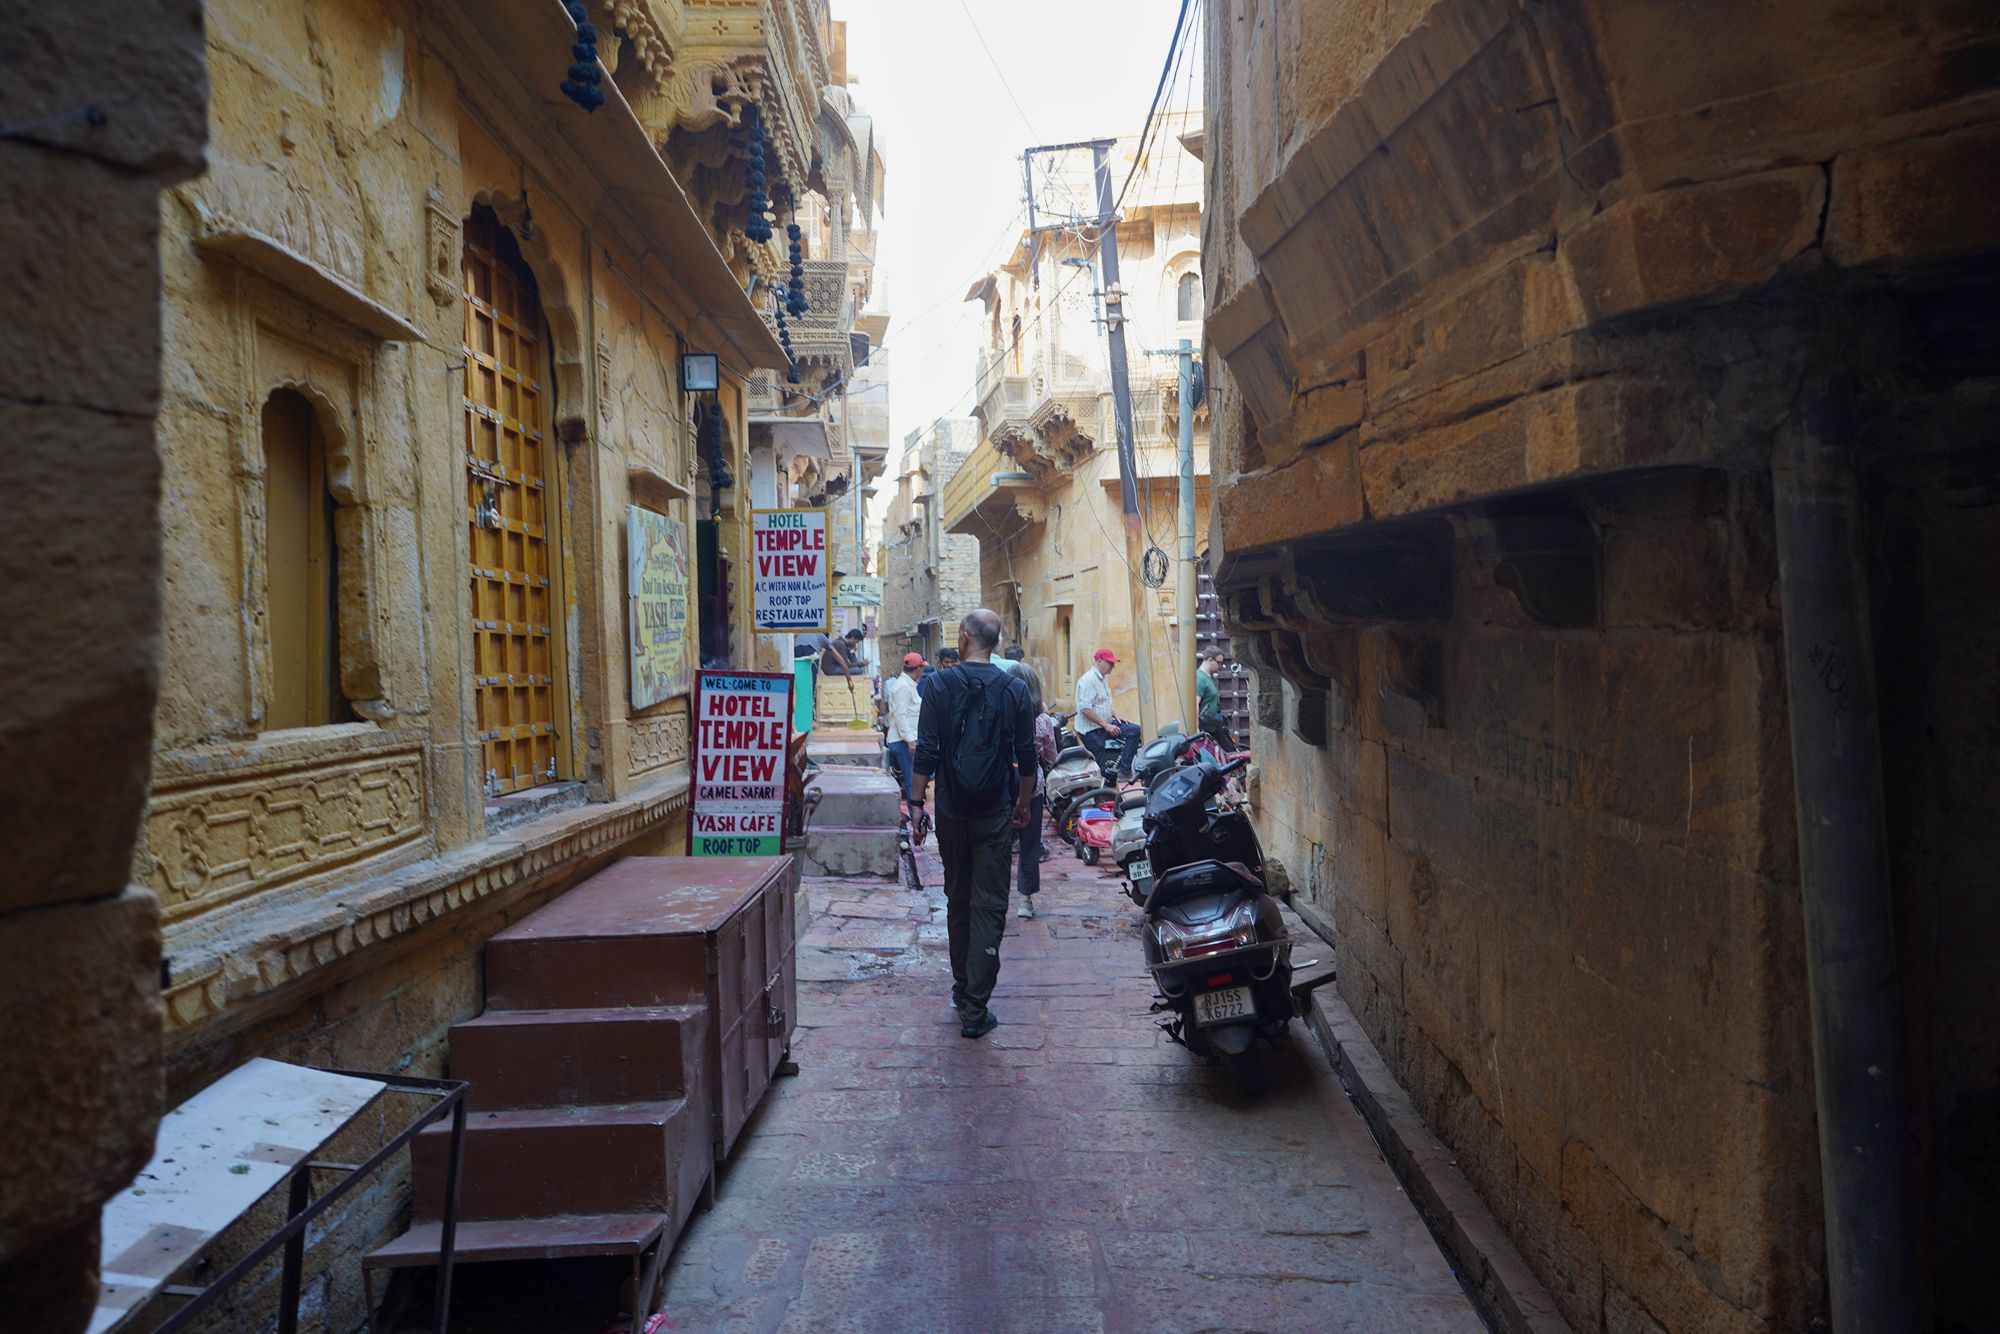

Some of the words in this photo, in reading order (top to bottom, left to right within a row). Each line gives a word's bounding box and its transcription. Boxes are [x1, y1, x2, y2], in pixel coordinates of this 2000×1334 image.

[768, 514, 807, 528] HOTEL
[755, 529, 825, 551] TEMPLE
[758, 555, 818, 577] VIEW
[768, 582, 787, 593] WITH
[787, 581, 801, 593] NON
[839, 584, 867, 592] CAFE
[769, 596, 793, 607] ROOF
[795, 595, 812, 606] TOP
[643, 601, 668, 629] YASH
[756, 608, 825, 621] RESTAURANT
[761, 680, 772, 691] TO
[709, 695, 776, 717] HOTEL
[700, 720, 784, 750] TEMPLE
[702, 755, 777, 782] VIEW
[701, 787, 738, 799] CAMEL
[740, 787, 775, 800] SAFARI
[696, 816, 736, 832] YASH
[740, 817, 776, 832] CAFE
[703, 838, 734, 855] ROOF
[736, 839, 761, 855] TOP
[1204, 989, 1241, 1007] RJ15S
[1204, 1003, 1244, 1021] K6722
